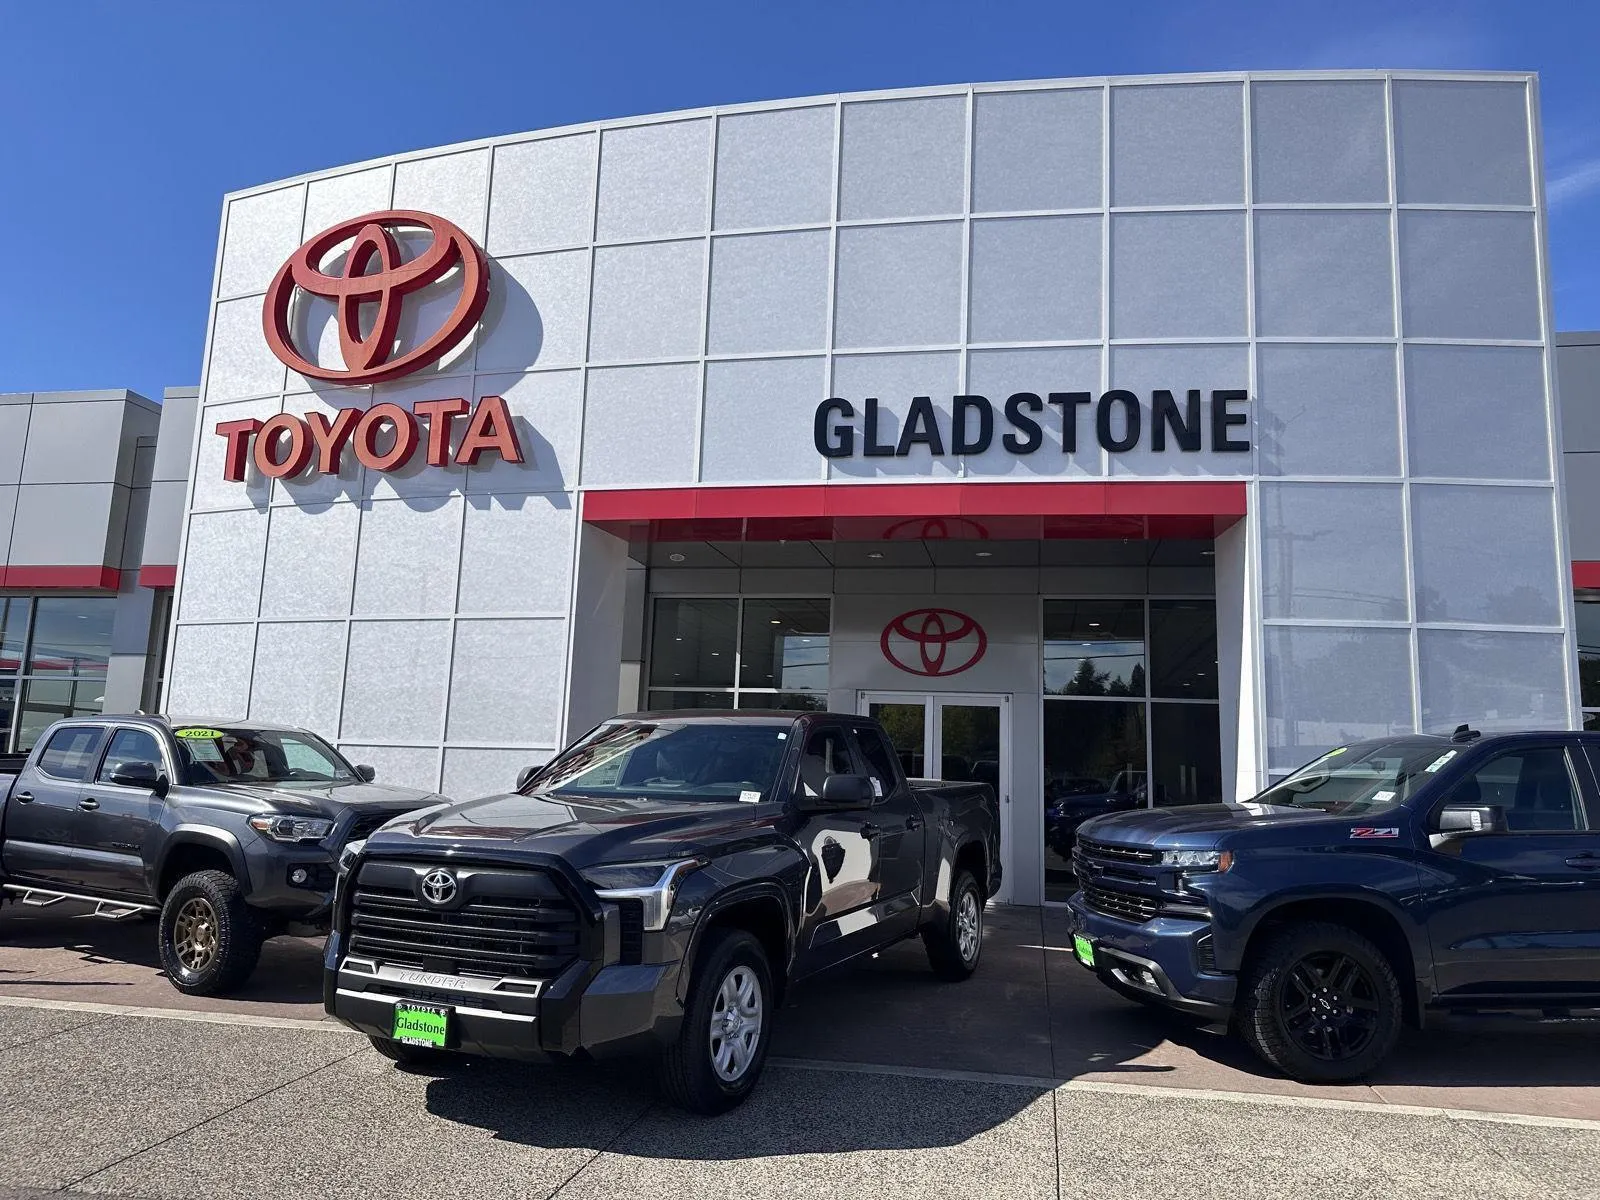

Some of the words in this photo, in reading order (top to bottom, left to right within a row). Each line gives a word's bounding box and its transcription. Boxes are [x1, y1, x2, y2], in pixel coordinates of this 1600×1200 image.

[813, 389, 1250, 457] GLADSTONE
[215, 395, 525, 482] TOYOTA
[400, 969, 468, 989] TUNDRA
[406, 1004, 436, 1013] TOYOTA
[396, 1017, 445, 1035] Gladstone
